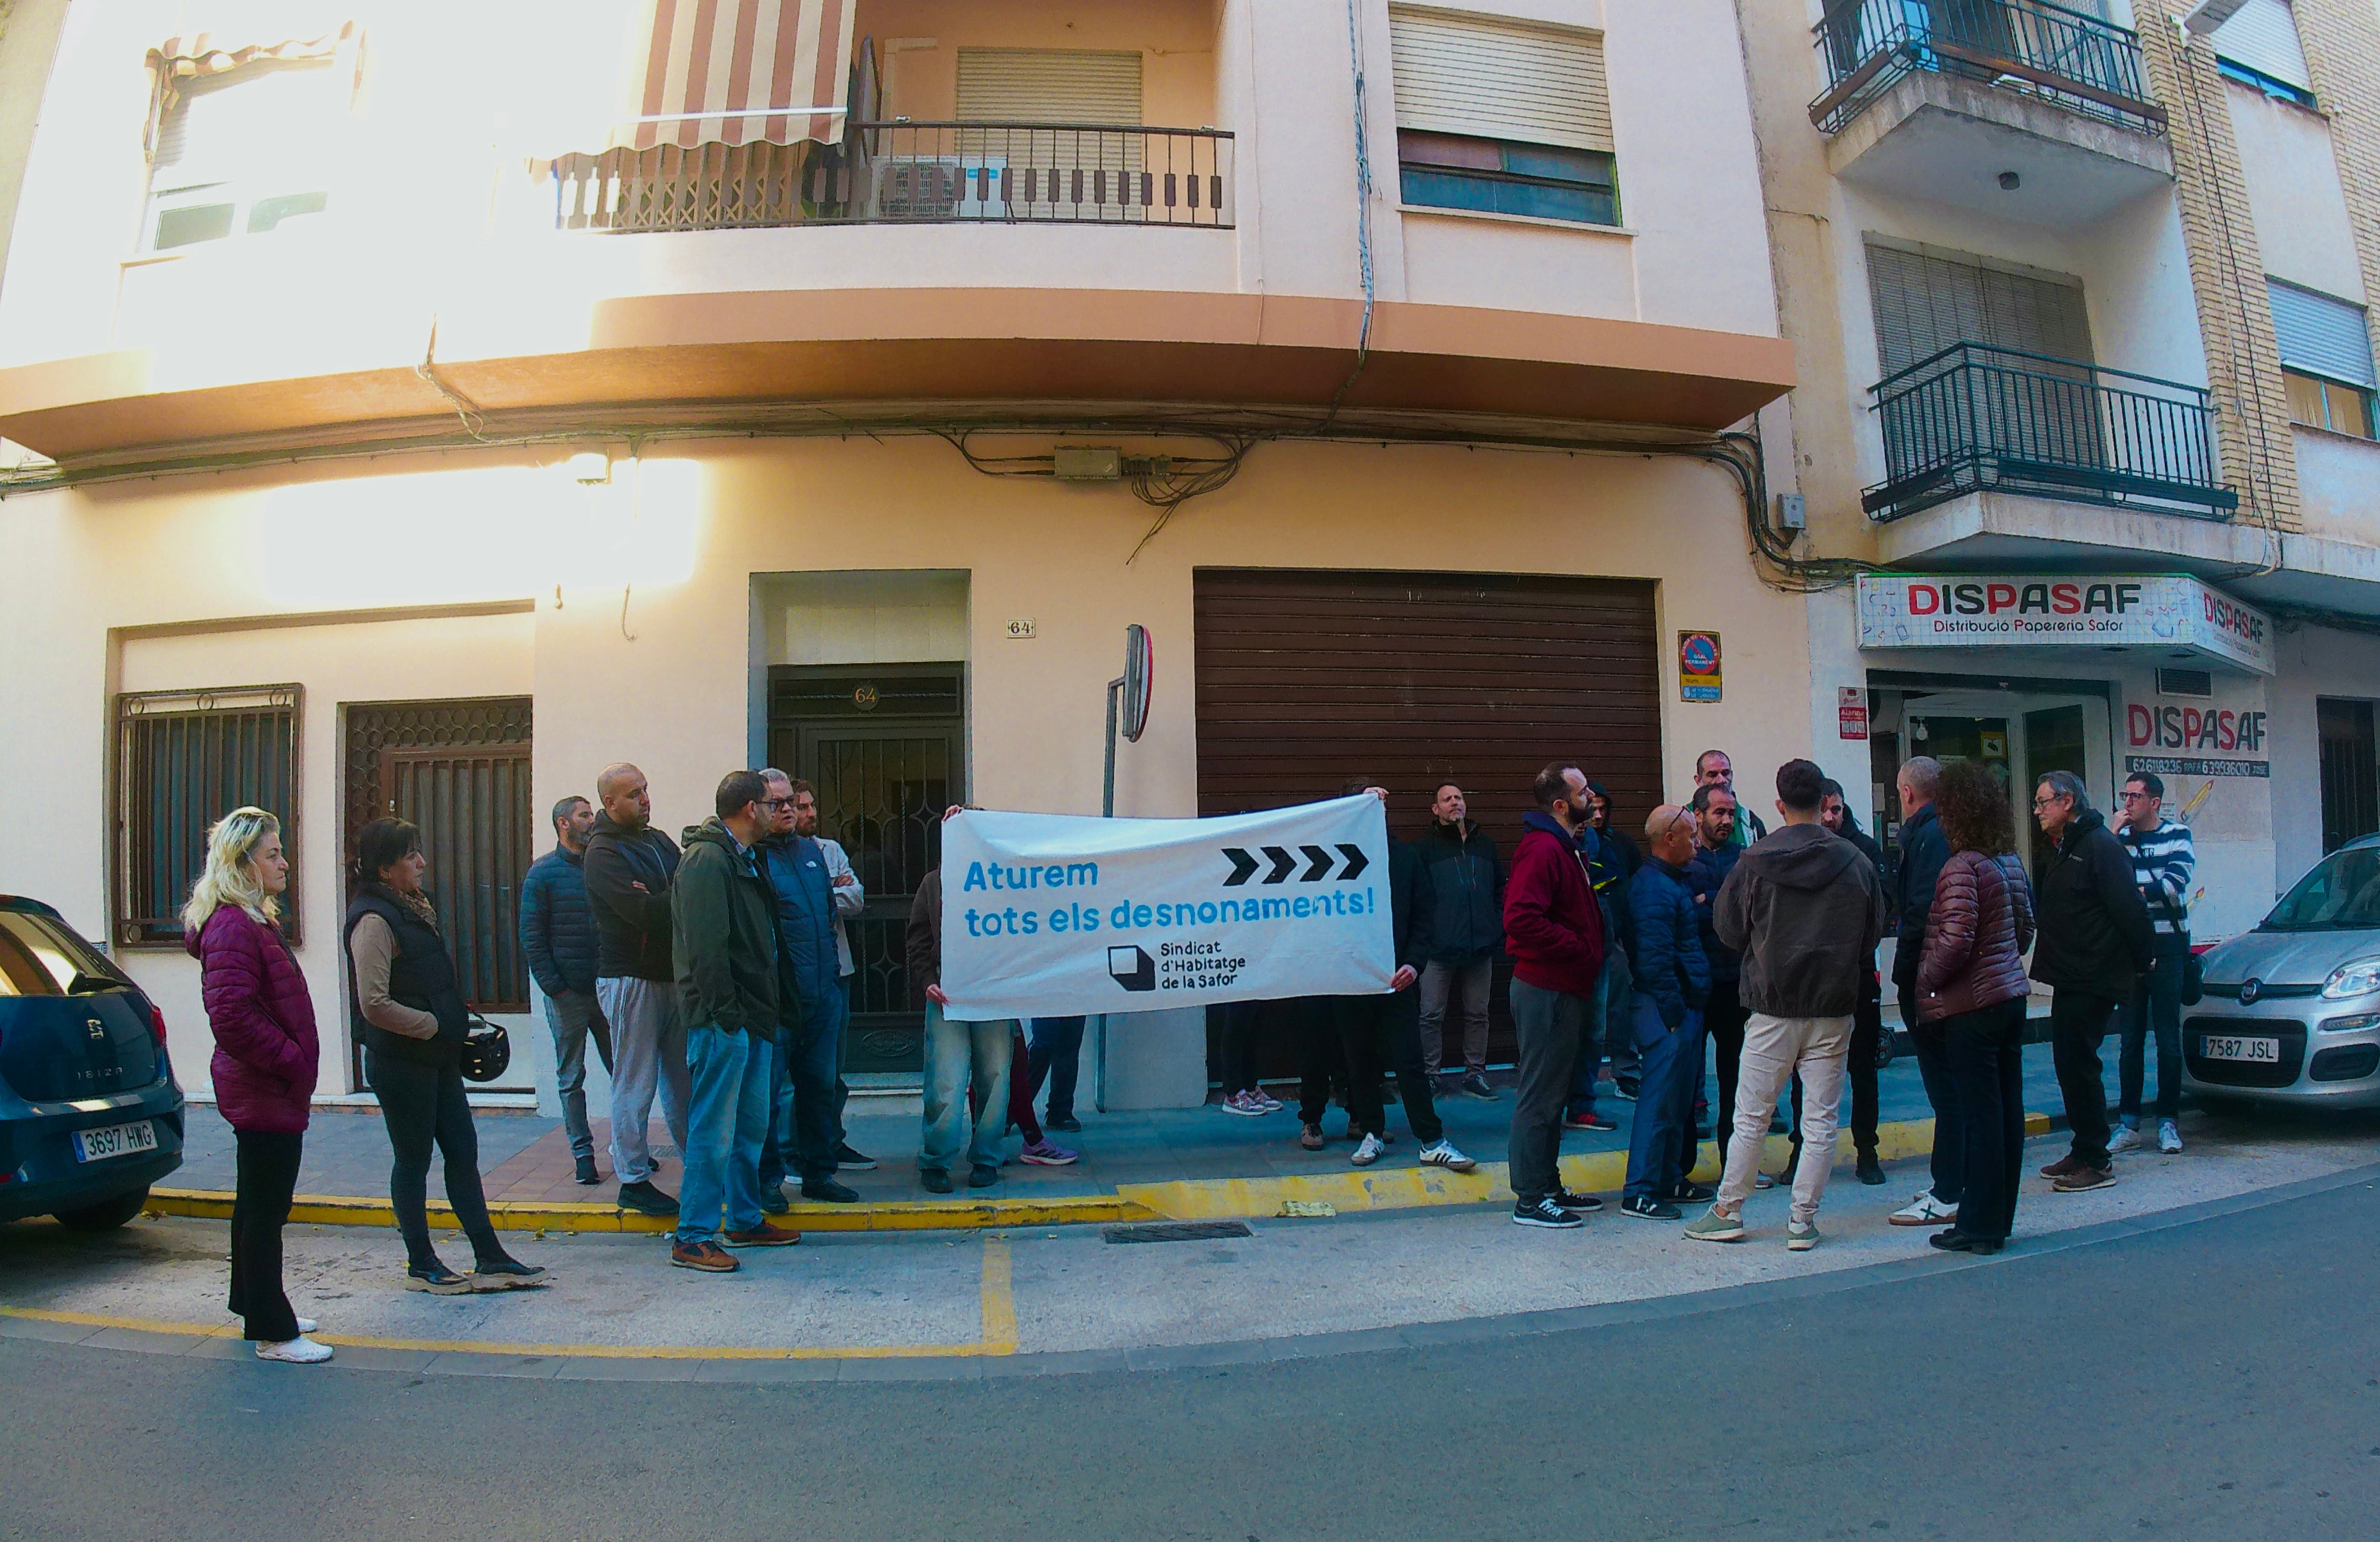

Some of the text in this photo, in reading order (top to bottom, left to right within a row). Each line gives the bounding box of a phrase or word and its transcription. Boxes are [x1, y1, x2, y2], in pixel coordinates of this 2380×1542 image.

[1908, 583, 2142, 615] DISPASAF
[1011, 622, 1030, 634] 64
[1934, 619, 2123, 634] Distribució Papereria Safor
[2204, 592, 2263, 645] DISPASAF
[855, 688, 876, 703] 64
[2128, 704, 2266, 751] DISPASAF
[963, 861, 1098, 892] Aturem
[965, 887, 1374, 937] tots els desnonaments!
[1160, 941, 1222, 957] Sindicat
[1161, 973, 1237, 989] de la Safor
[2208, 1039, 2274, 1059] 7587 JSL
[85, 1124, 152, 1156] 3697 HWG
